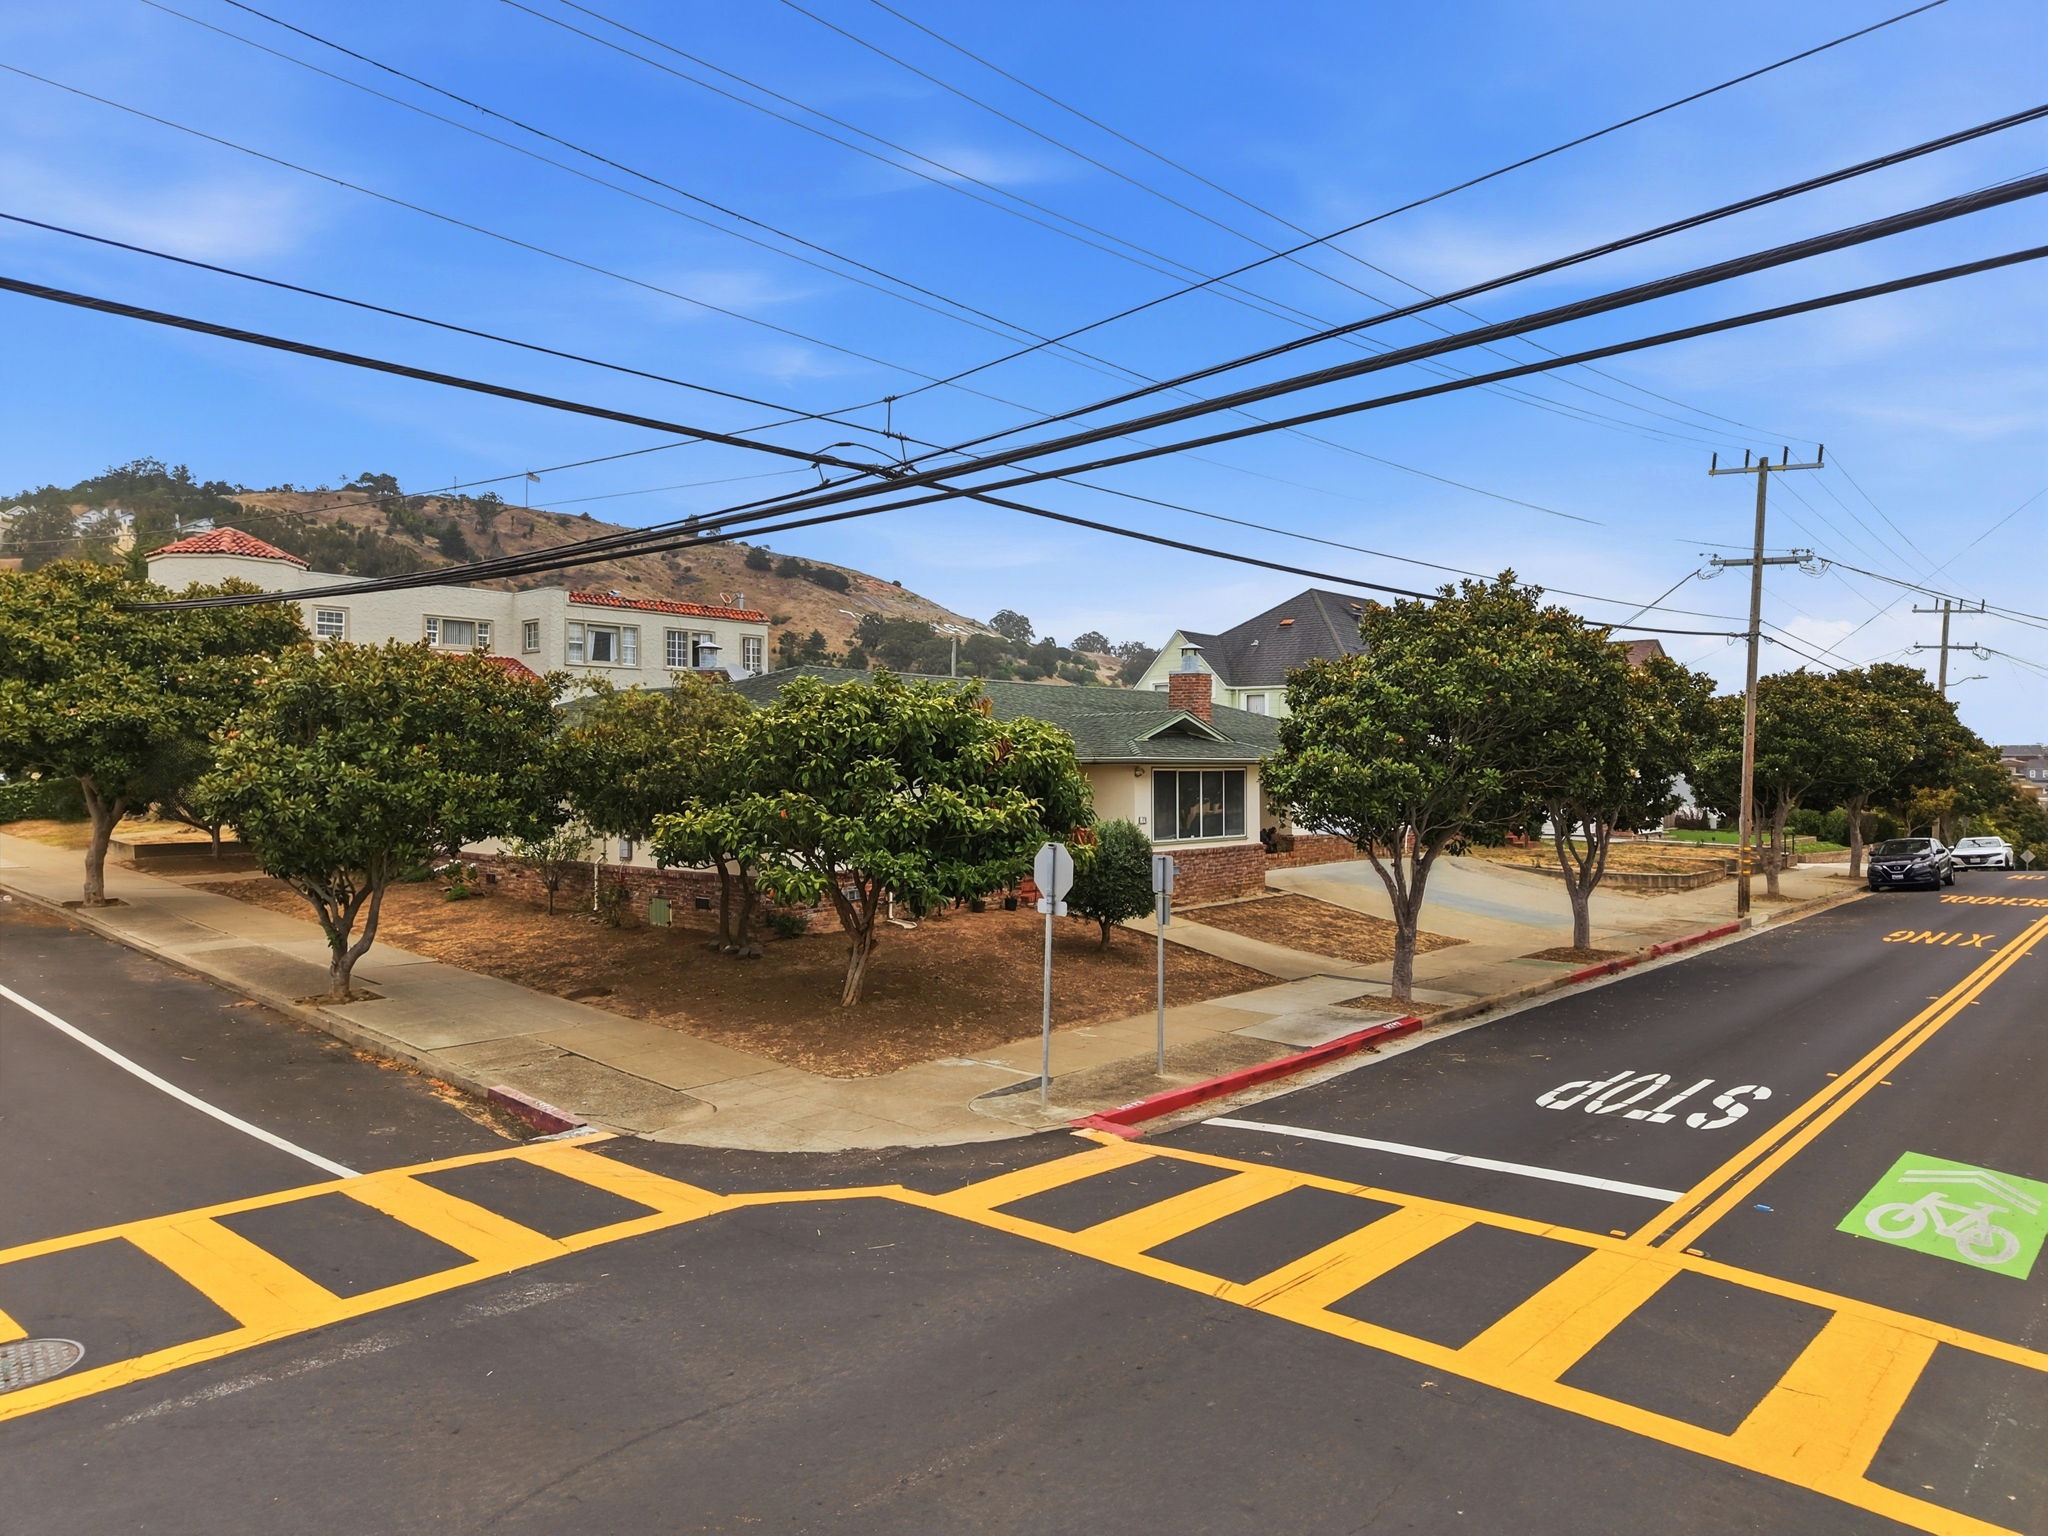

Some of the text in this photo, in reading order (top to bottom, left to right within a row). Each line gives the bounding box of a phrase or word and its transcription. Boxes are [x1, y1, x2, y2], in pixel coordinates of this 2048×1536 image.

[1940, 894, 2048, 908] SCHOOL
[1882, 930, 1996, 947] XING
[1535, 1070, 1772, 1130] STOP
